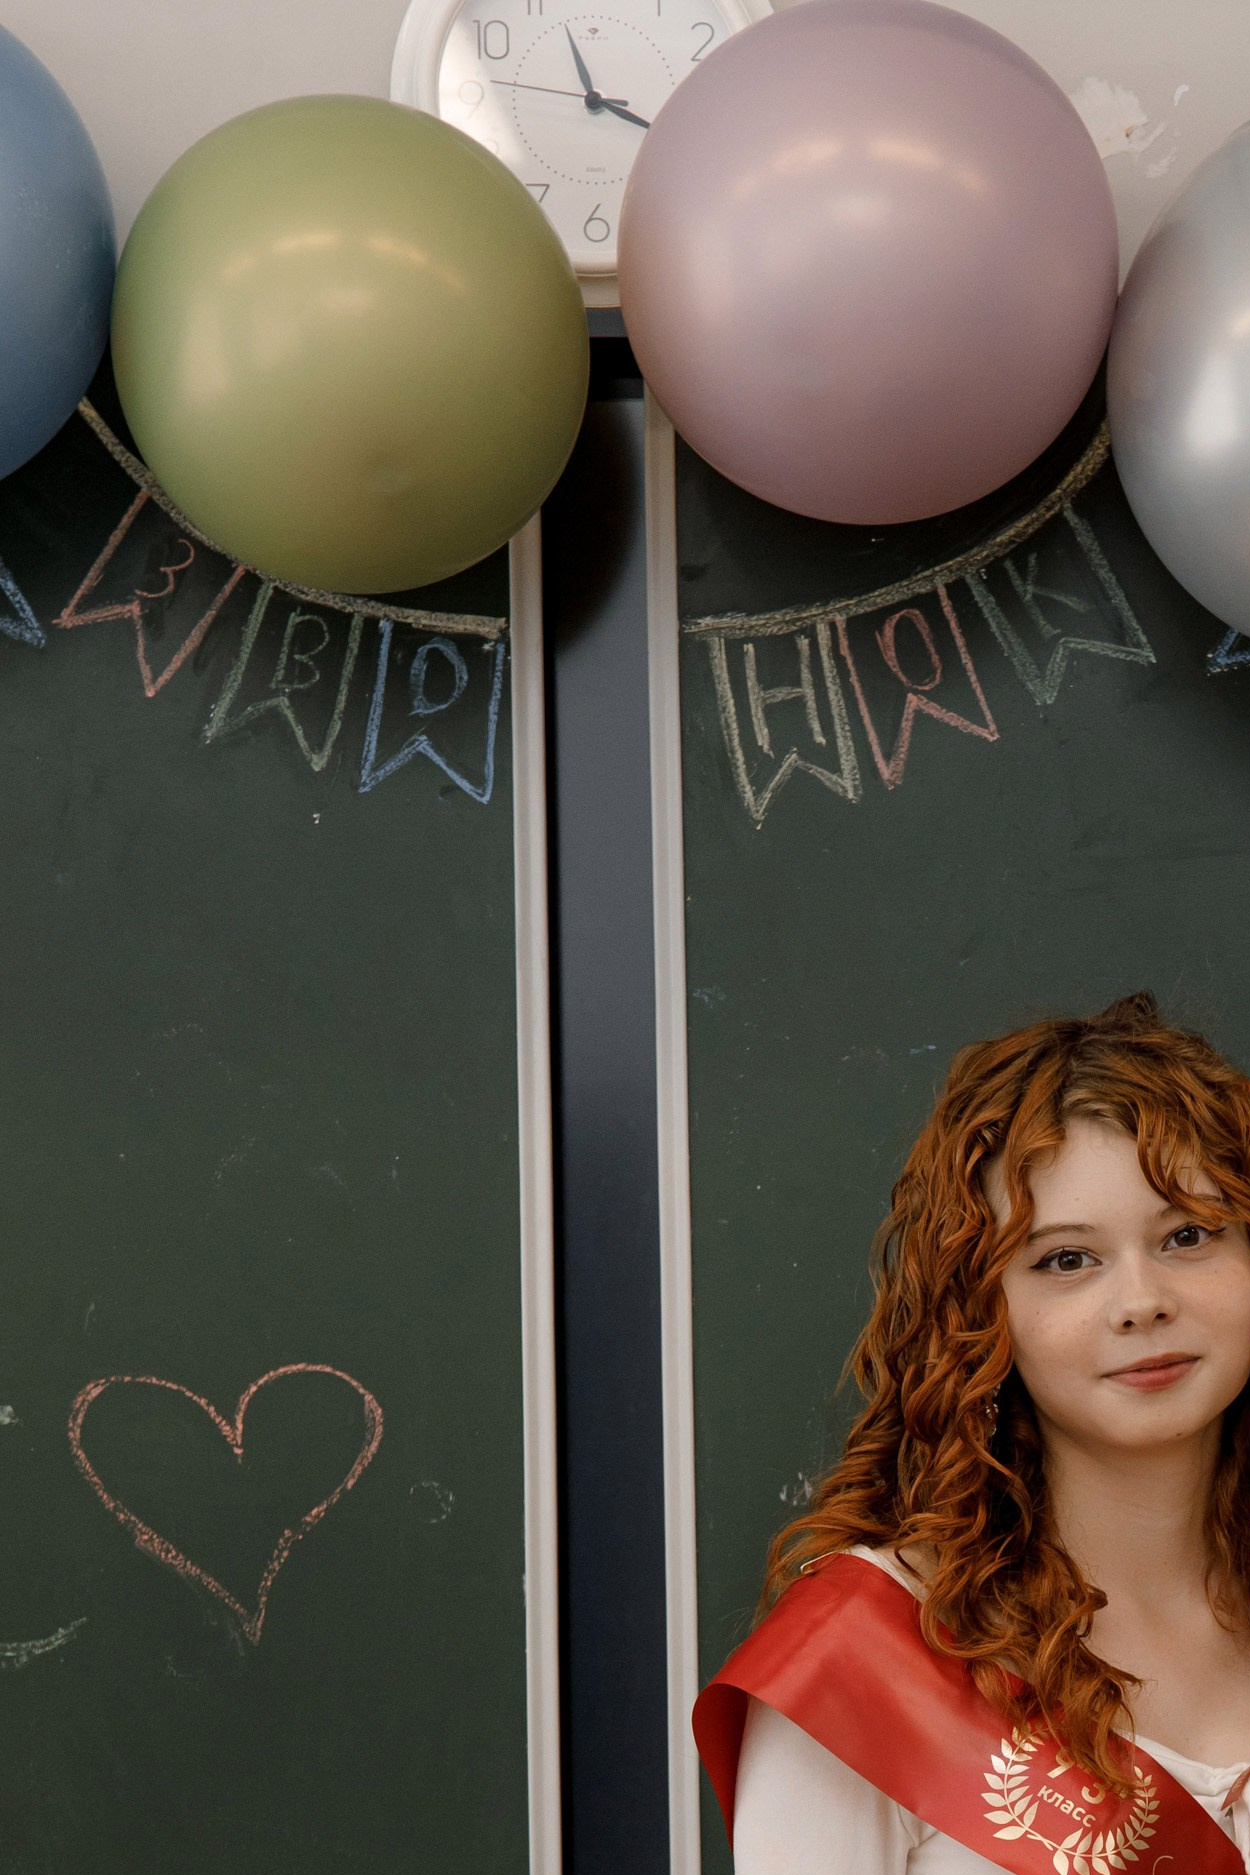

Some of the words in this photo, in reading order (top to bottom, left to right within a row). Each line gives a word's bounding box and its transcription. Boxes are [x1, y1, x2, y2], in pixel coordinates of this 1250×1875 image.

[472, 19, 511, 60] 10
[690, 22, 715, 62] 2
[457, 79, 485, 119] 9
[583, 202, 611, 243] 6
[1036, 1784, 1097, 1828] класс
